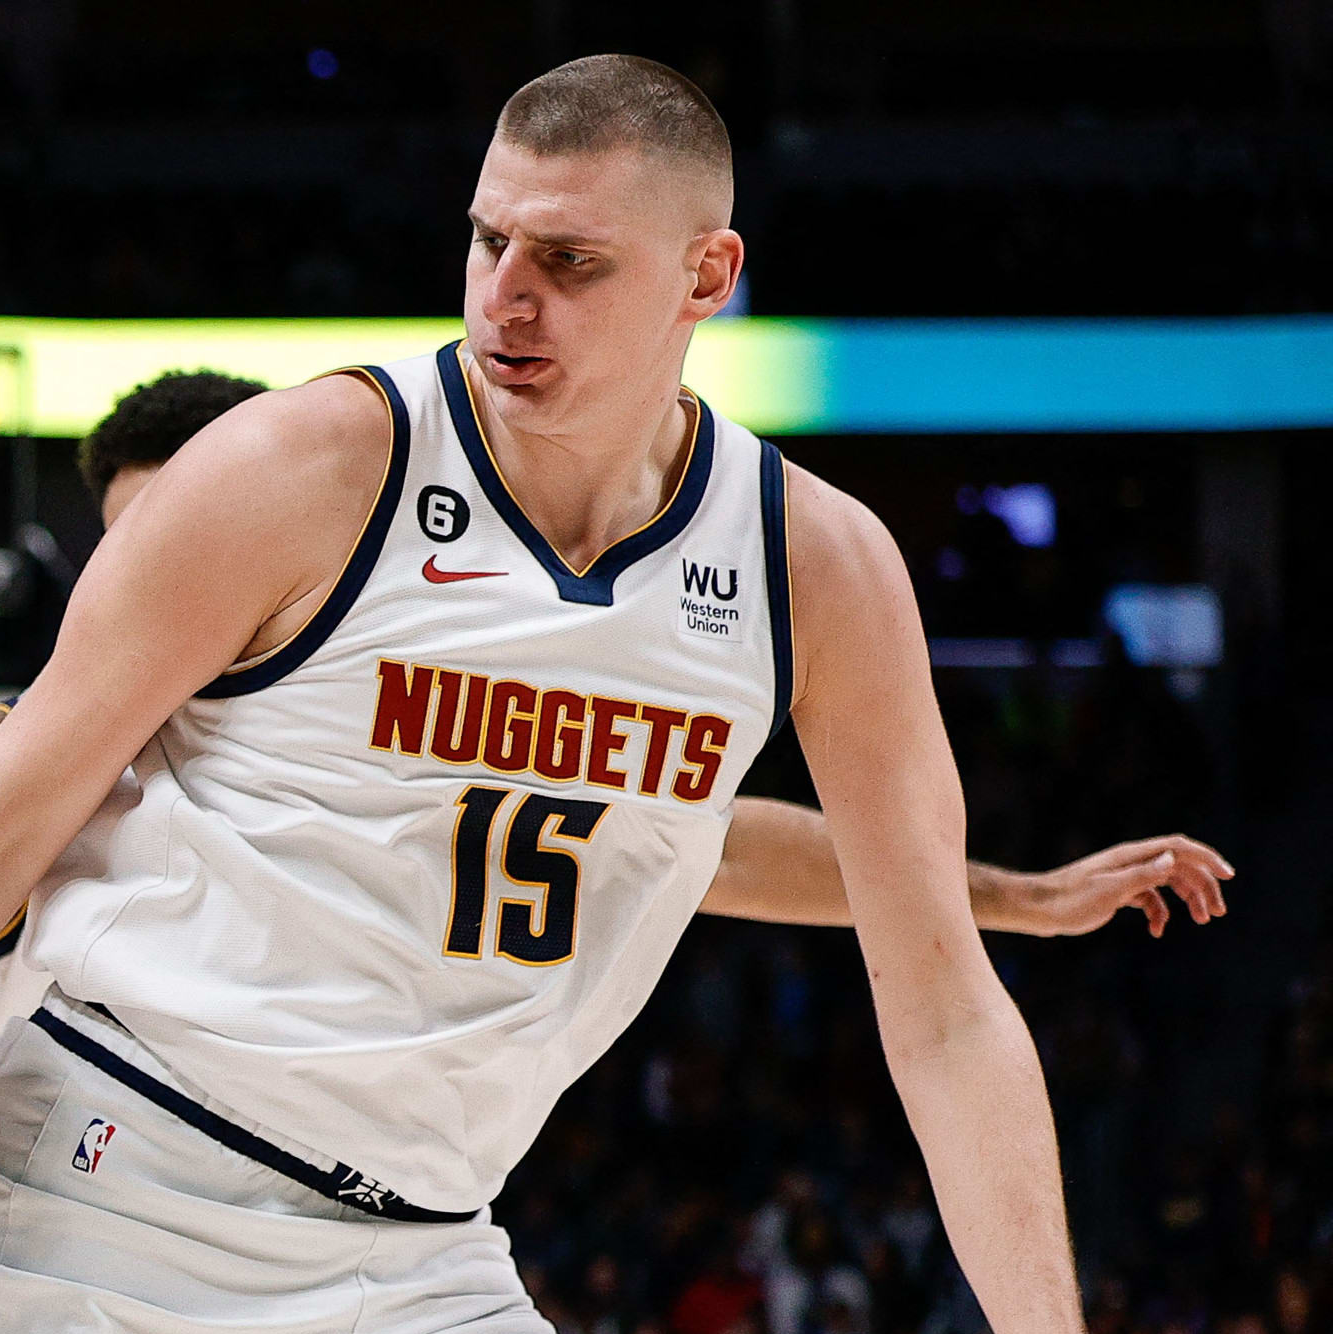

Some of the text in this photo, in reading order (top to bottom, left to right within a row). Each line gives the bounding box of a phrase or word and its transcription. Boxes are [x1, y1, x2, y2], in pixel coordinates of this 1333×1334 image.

[426, 494, 456, 536] 6
[682, 557, 738, 602] WU
[680, 596, 739, 621] Western
[687, 613, 729, 635] Union
[369, 657, 733, 801] NUGGETS
[442, 785, 614, 966] 15
